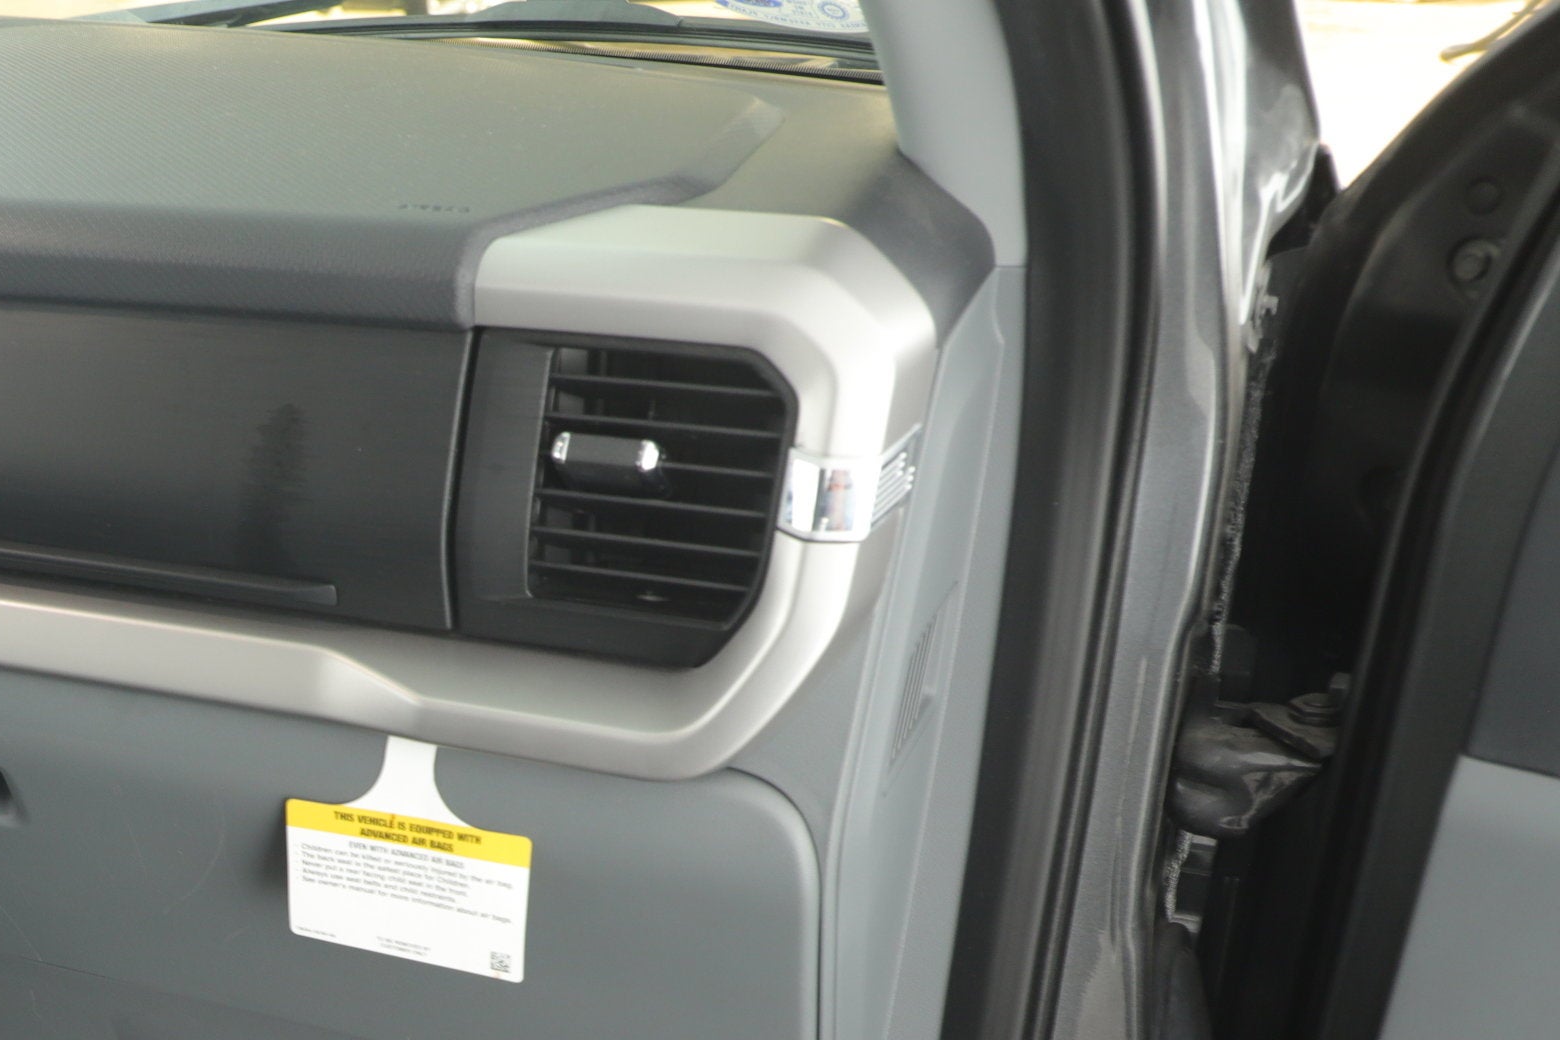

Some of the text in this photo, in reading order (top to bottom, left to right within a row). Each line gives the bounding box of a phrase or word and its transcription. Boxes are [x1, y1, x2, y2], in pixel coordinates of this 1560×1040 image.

[334, 811, 482, 844] THIS VEHICLE IS EQUIPPED WITH
[361, 828, 454, 852] ADVANCED AIR BAGS
